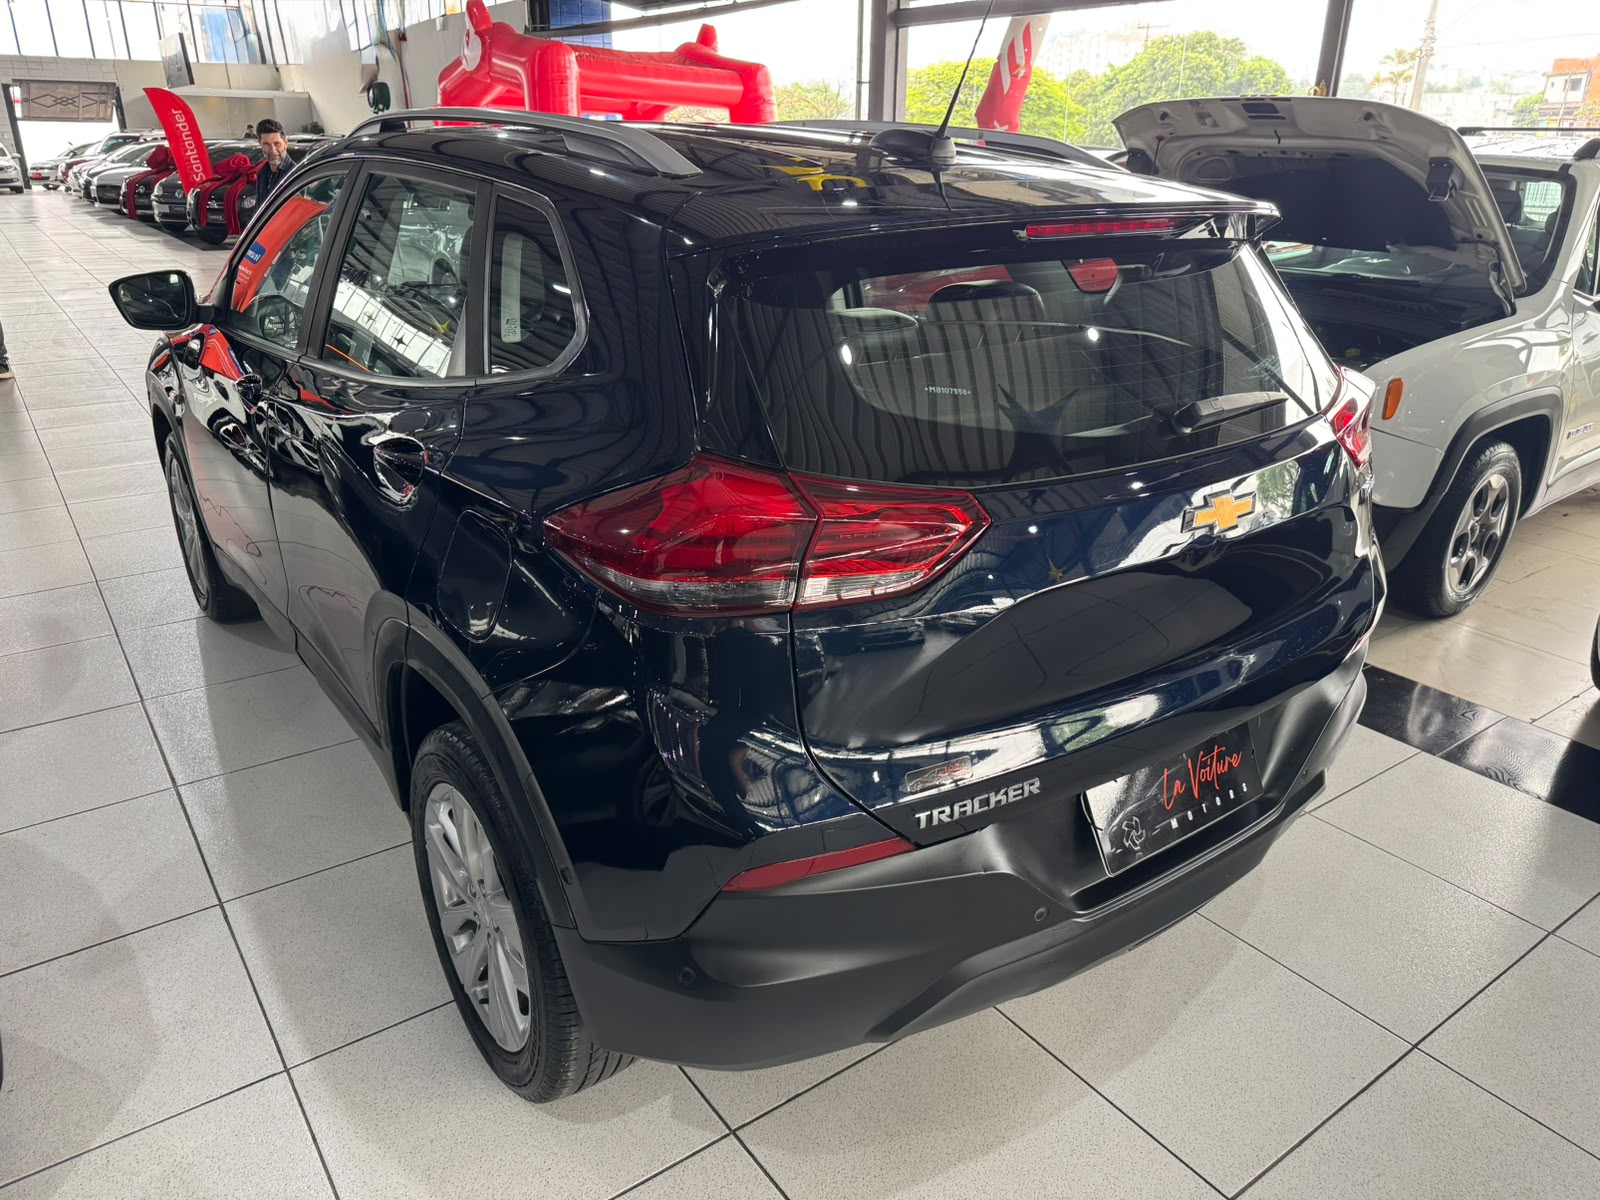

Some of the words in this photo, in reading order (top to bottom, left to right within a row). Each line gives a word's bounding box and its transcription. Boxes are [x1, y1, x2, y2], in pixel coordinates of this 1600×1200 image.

[171, 108, 206, 182] Santander
[915, 777, 1040, 829] TRACKER
[1163, 768, 1186, 811] La
[1187, 744, 1242, 799] Voiture
[1170, 782, 1247, 829] MOTORS
